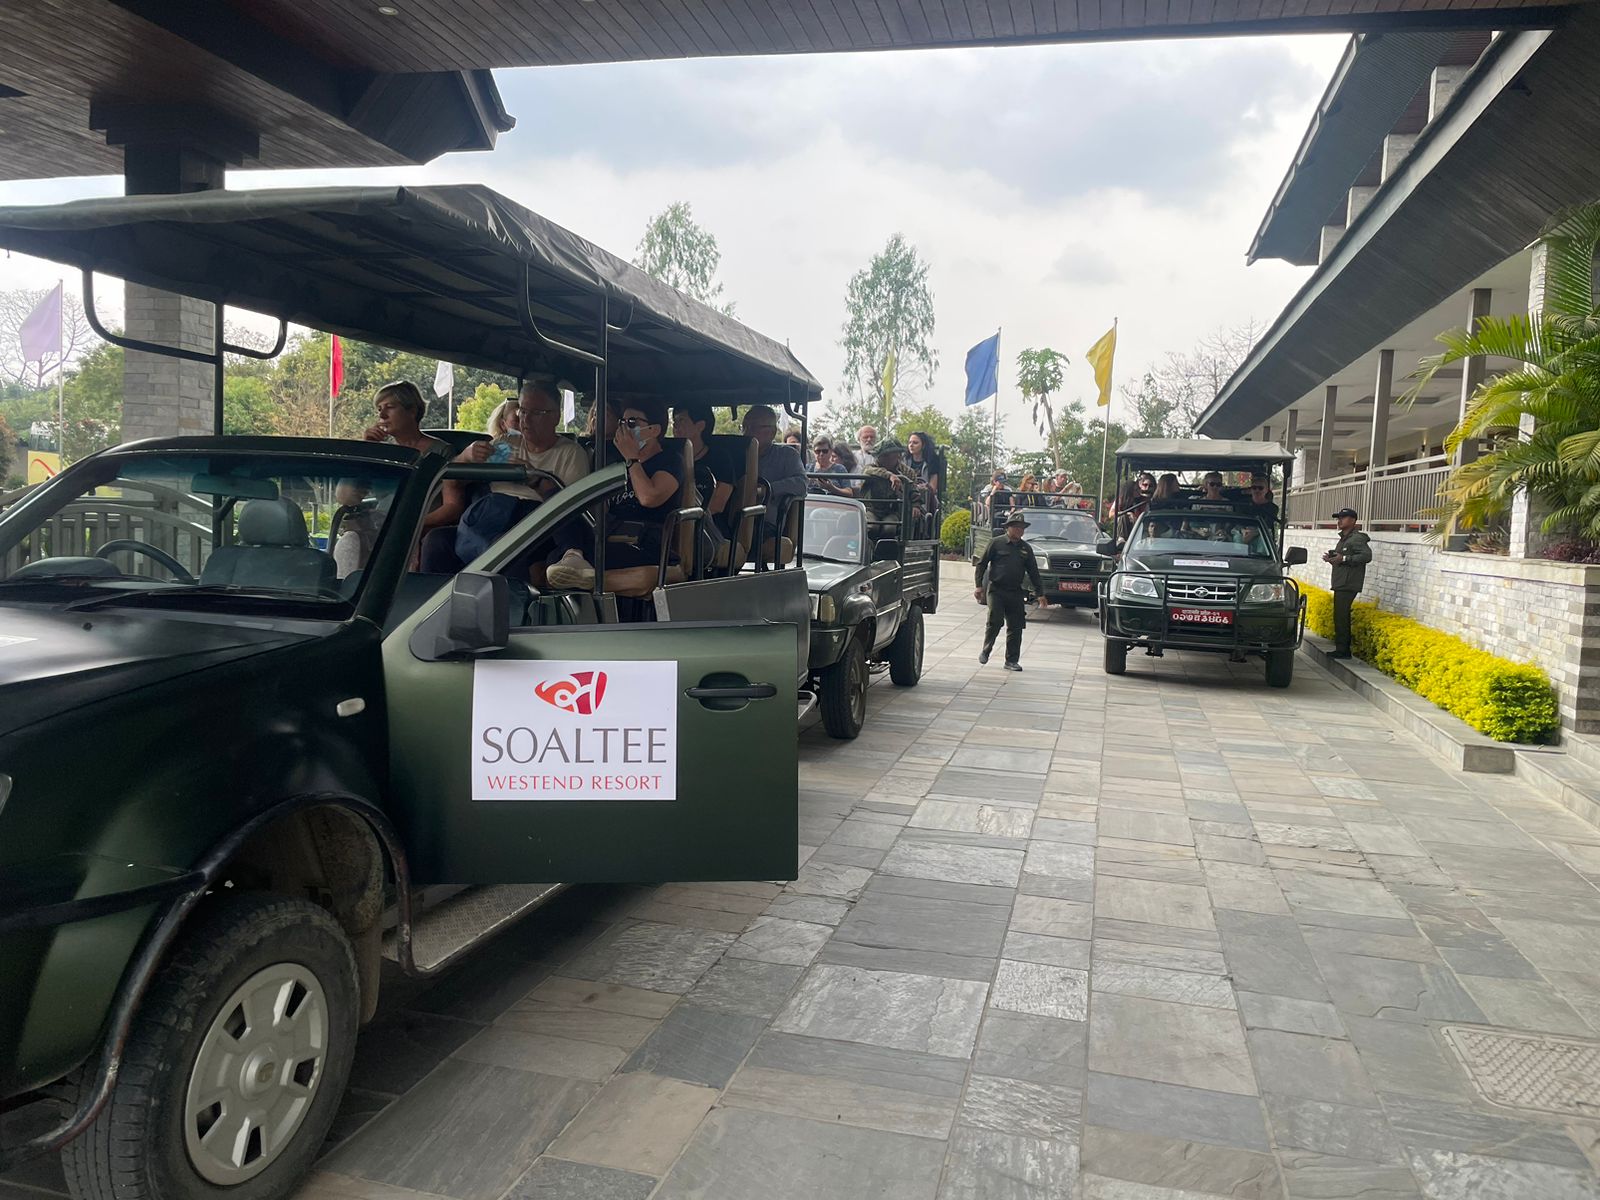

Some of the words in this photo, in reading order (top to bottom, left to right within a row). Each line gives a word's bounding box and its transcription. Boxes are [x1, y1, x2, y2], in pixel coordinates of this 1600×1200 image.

[482, 726, 667, 764] SOALTEE
[487, 775, 584, 790] WESTEND
[592, 775, 662, 790] RESORT
